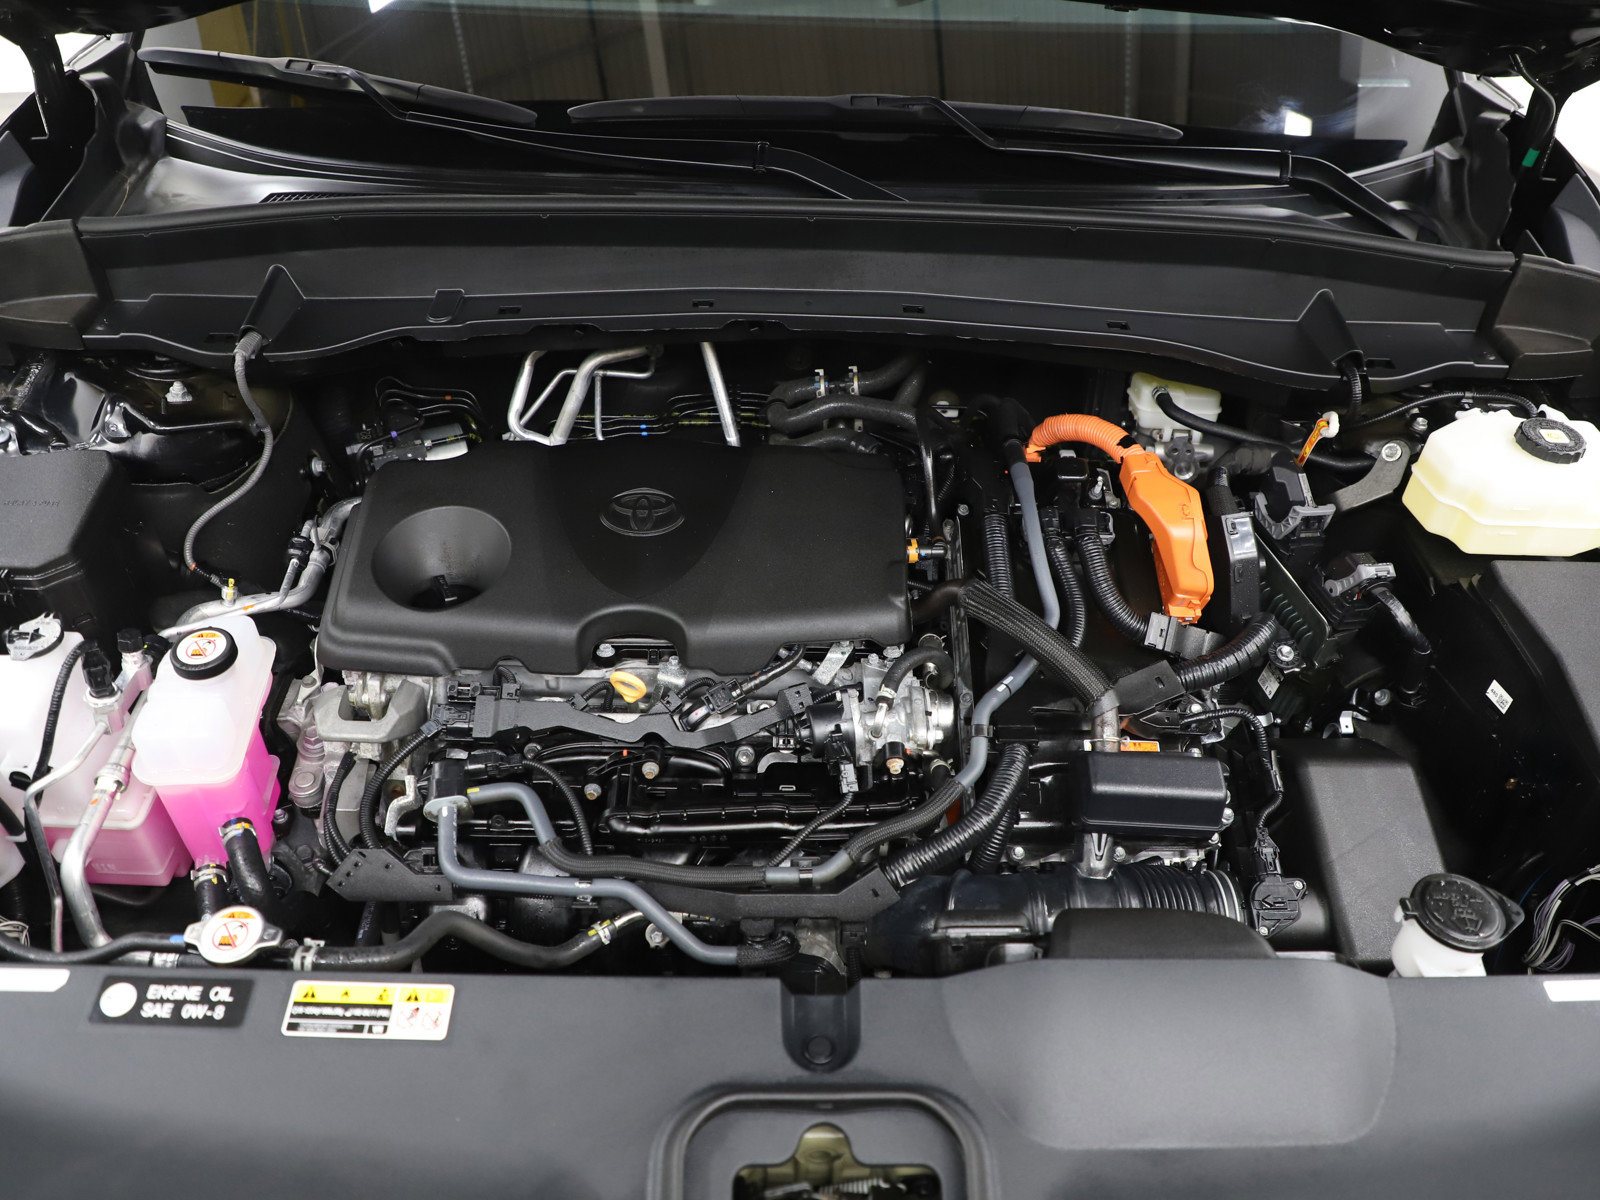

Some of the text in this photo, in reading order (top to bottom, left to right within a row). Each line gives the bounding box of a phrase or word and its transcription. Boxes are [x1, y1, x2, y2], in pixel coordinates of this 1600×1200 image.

[146, 984, 235, 1003] ENGINE OIL
[140, 1001, 175, 1019] SAE
